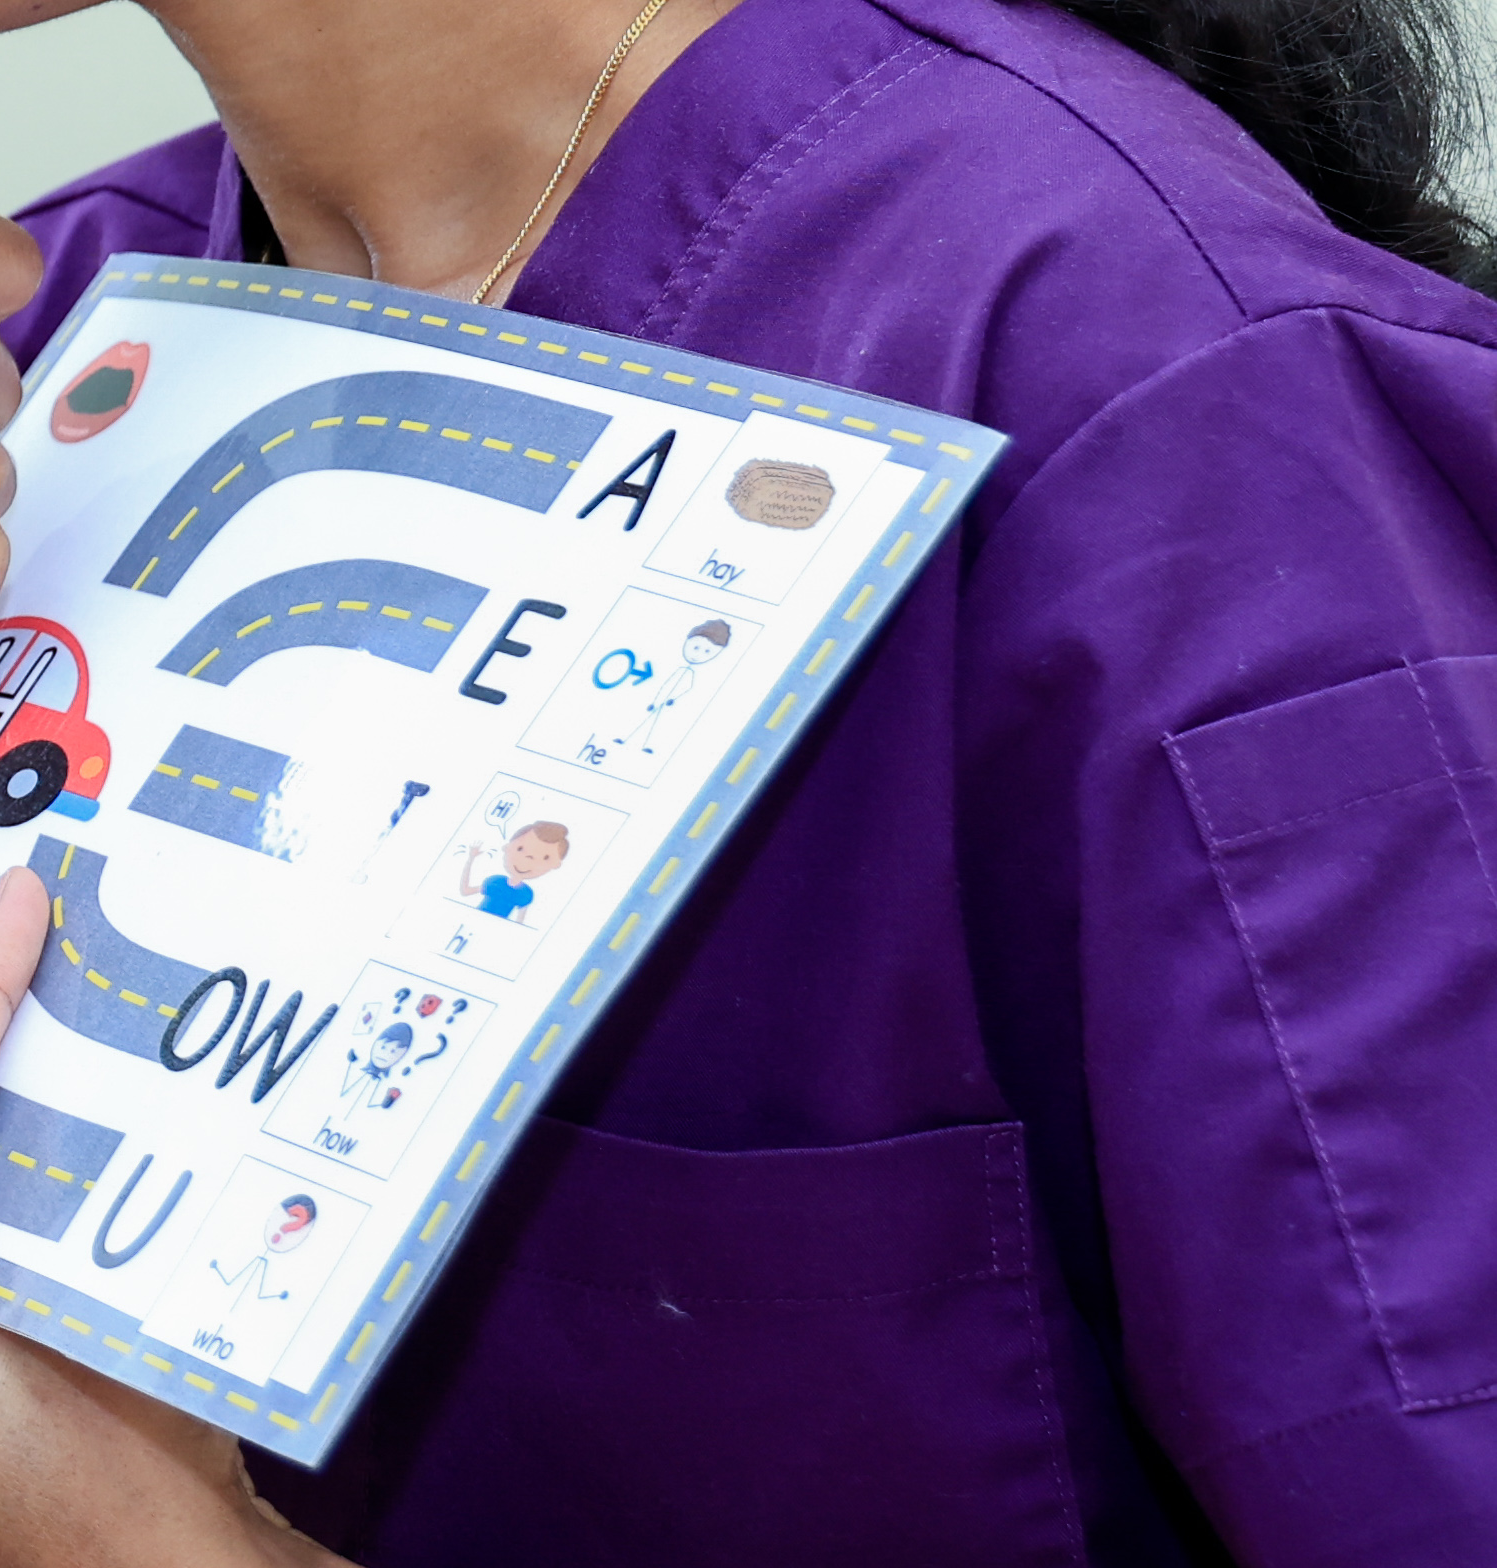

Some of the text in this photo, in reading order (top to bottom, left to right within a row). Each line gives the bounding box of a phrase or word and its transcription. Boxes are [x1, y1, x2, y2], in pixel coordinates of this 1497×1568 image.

[576, 428, 677, 532] A
[698, 547, 746, 589] hay
[457, 597, 568, 706] E
[576, 732, 607, 766] he
[490, 799, 515, 819] Hi
[445, 923, 473, 955] hi
[158, 965, 340, 1105] OW
[312, 1115, 359, 1156] how
[91, 1153, 194, 1270] U
[192, 1323, 235, 1361] who
